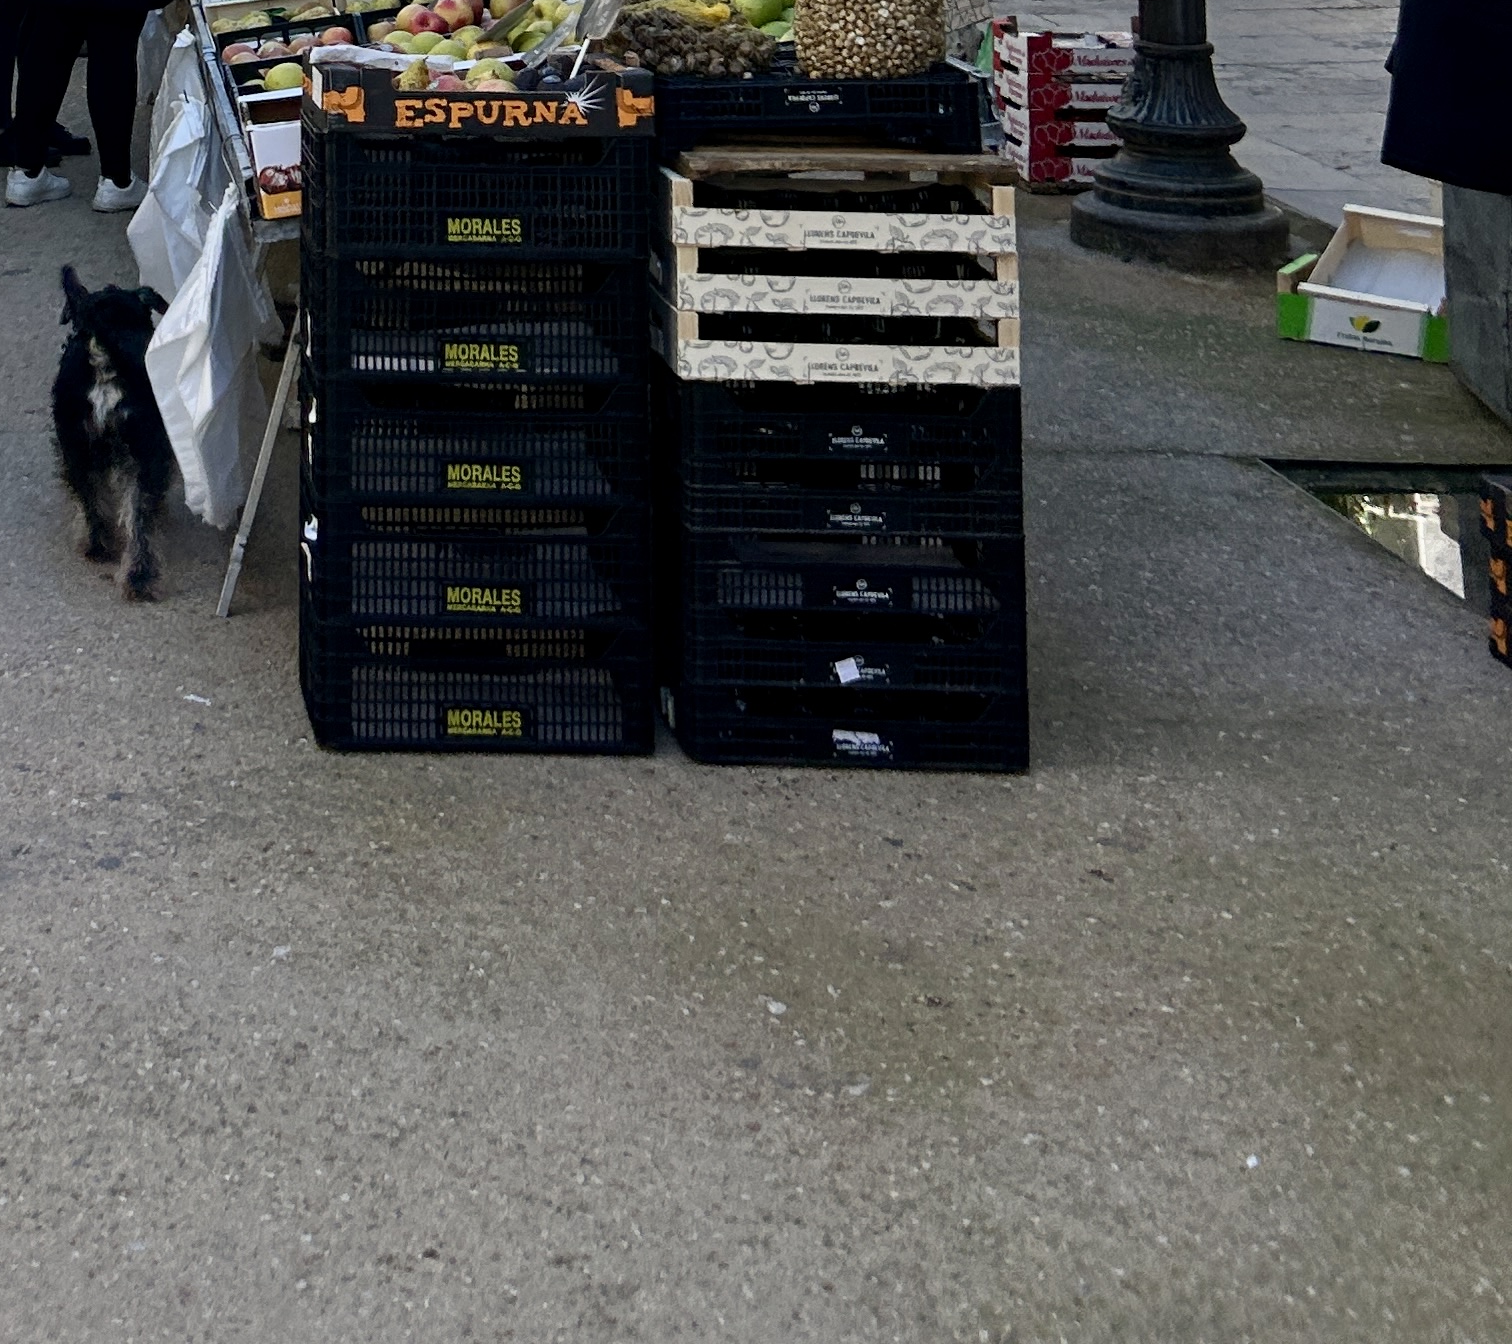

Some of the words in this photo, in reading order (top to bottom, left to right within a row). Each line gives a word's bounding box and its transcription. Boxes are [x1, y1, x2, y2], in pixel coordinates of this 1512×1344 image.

[394, 98, 588, 129] ESPURNA
[447, 217, 522, 235] MORALES
[445, 343, 519, 362] MORALES
[447, 463, 522, 483] MORALES
[447, 586, 522, 606] MORALES
[447, 709, 523, 728] MORALES
